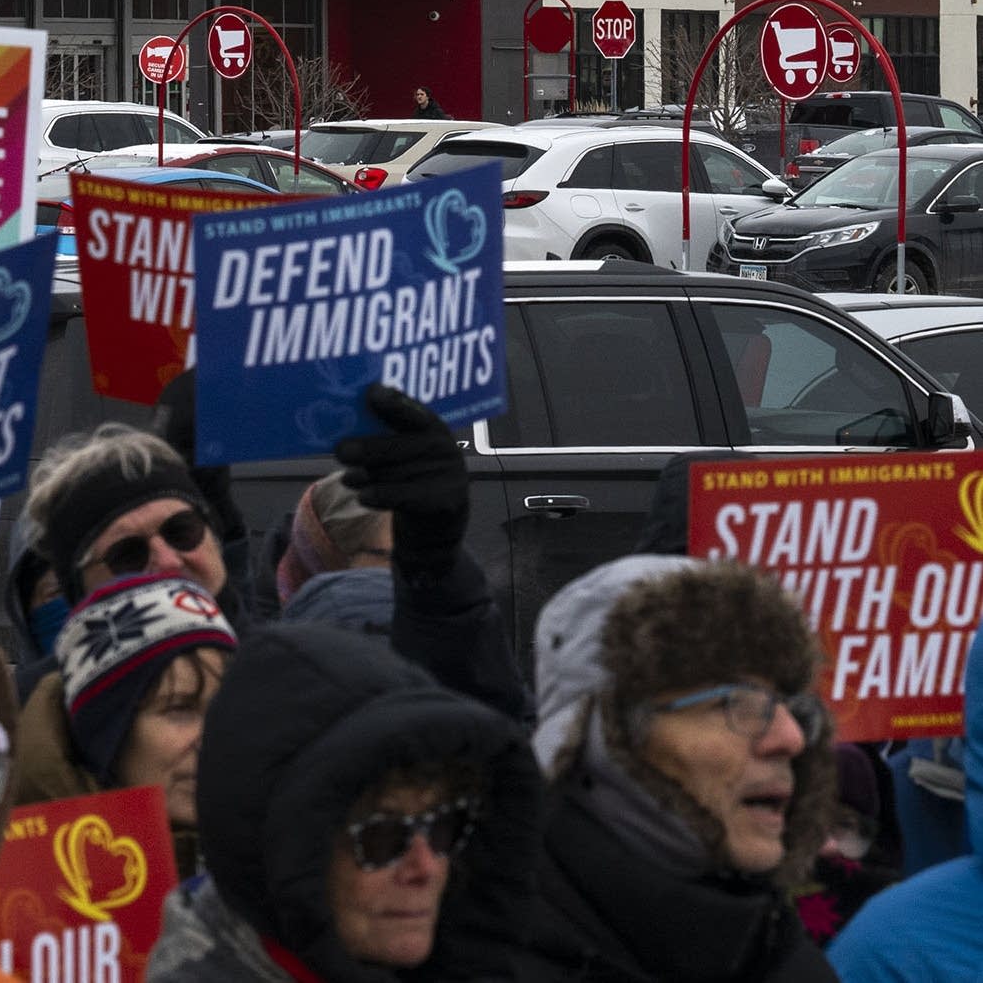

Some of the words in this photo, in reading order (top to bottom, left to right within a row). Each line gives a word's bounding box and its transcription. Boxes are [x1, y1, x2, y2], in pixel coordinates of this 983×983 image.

[596, 18, 632, 39] STOP
[148, 62, 173, 70] SECURY
[78, 180, 125, 202] STAND
[128, 188, 167, 208] WITH
[204, 217, 267, 240] STAND
[272, 210, 317, 232] WITH
[321, 192, 423, 224] IMMIGRANTS
[130, 270, 196, 329] WIT
[213, 228, 394, 309] DEFEND
[244, 268, 482, 368] IMMIGRANT
[381, 325, 496, 405] RIGHTS
[703, 469, 769, 492] STAND
[773, 467, 825, 489] WITH
[830, 461, 956, 485] IMMIGRANTS
[709, 497, 879, 566] STAND
[910, 561, 983, 630] OU
[831, 631, 976, 702] FAMI
[31, 920, 122, 983] OUR
